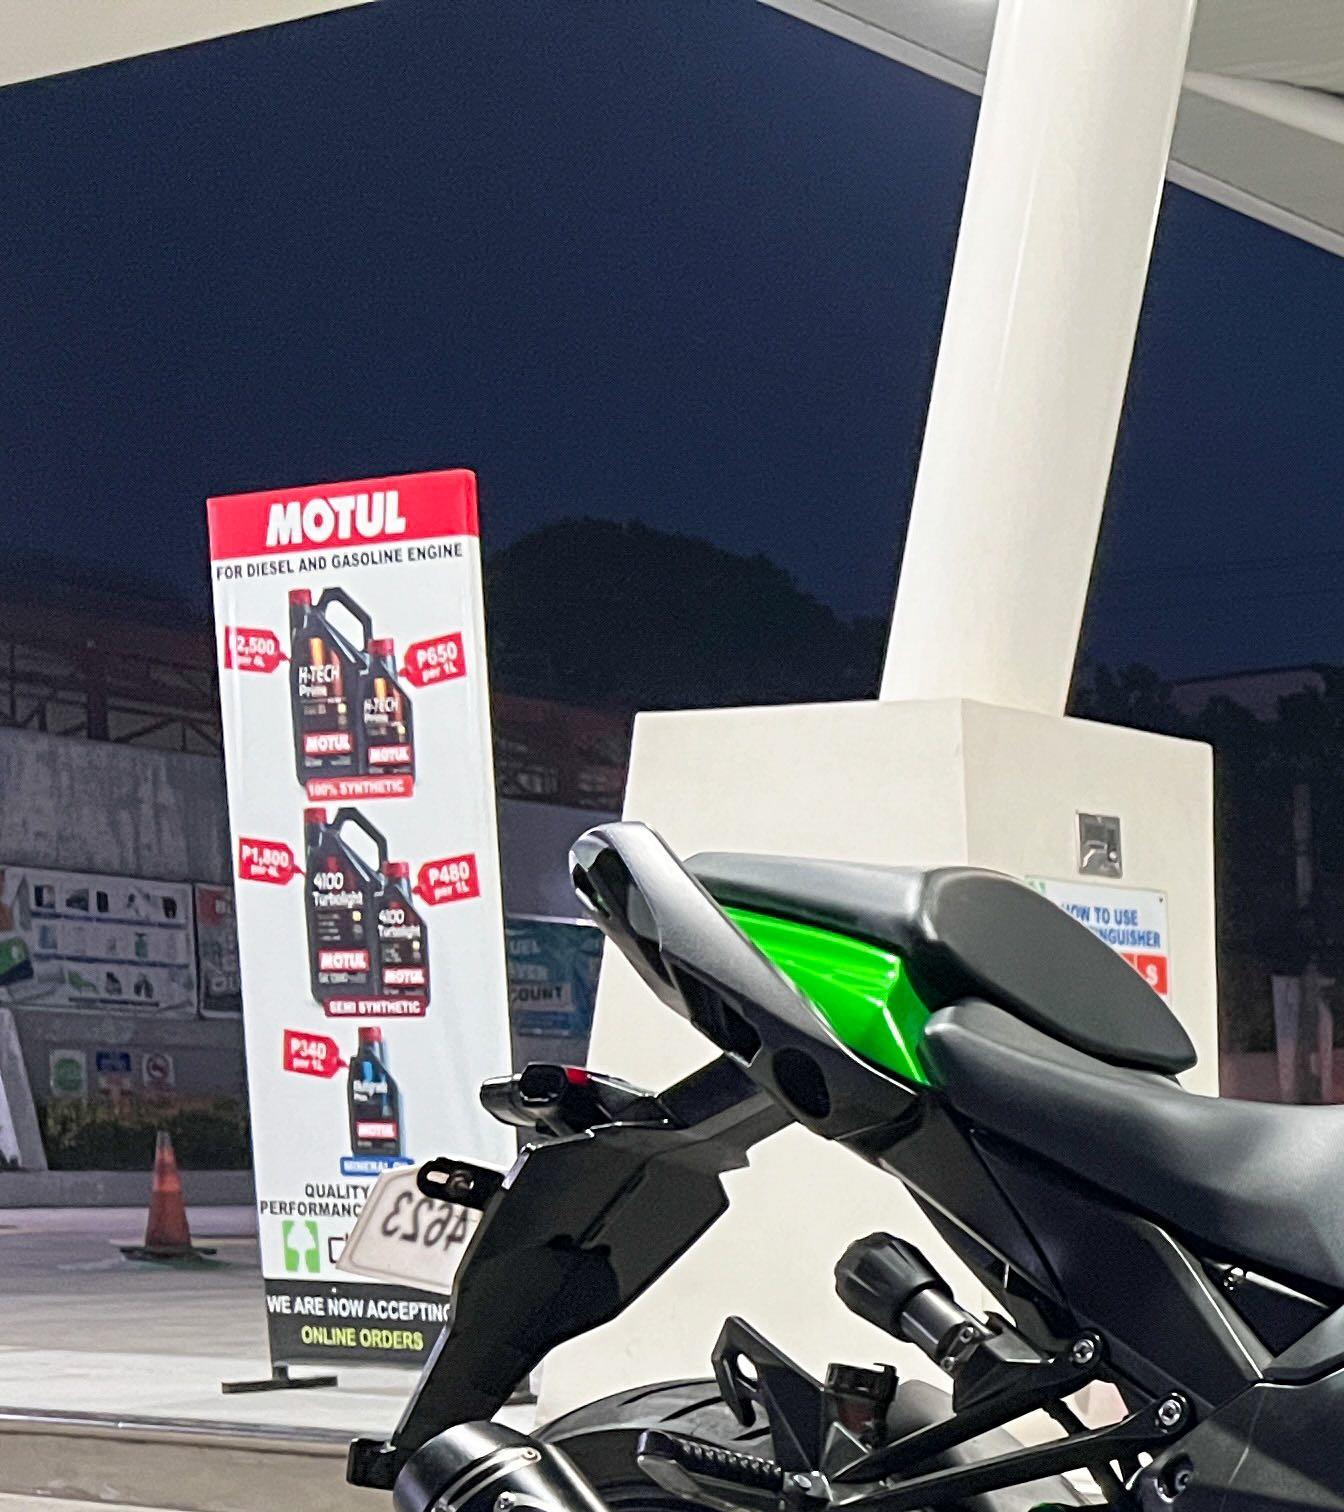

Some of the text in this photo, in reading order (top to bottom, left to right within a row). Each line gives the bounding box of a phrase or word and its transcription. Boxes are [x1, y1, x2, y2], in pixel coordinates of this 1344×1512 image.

[266, 490, 407, 547] MOTUL
[216, 543, 463, 581] FOR DIESEL AND GASOLINE ENGINE
[305, 735, 350, 753] MOTUL
[369, 747, 409, 763] MOTUL
[1094, 906, 1111, 925] TO
[1114, 908, 1138, 927] USE
[1095, 927, 1161, 949] NGUISHER
[319, 951, 367, 970] MOTUL
[384, 968, 425, 985] MOTUL
[358, 1000, 421, 1015] SYNTHETIC
[305, 1183, 371, 1200] QUALITY
[260, 1200, 363, 1218] PERFORMANC
[266, 1295, 292, 1315] WE
[293, 1296, 325, 1317] ARE
[328, 1299, 365, 1319] NOW
[301, 1325, 424, 1351] ONLINE ORDERS
